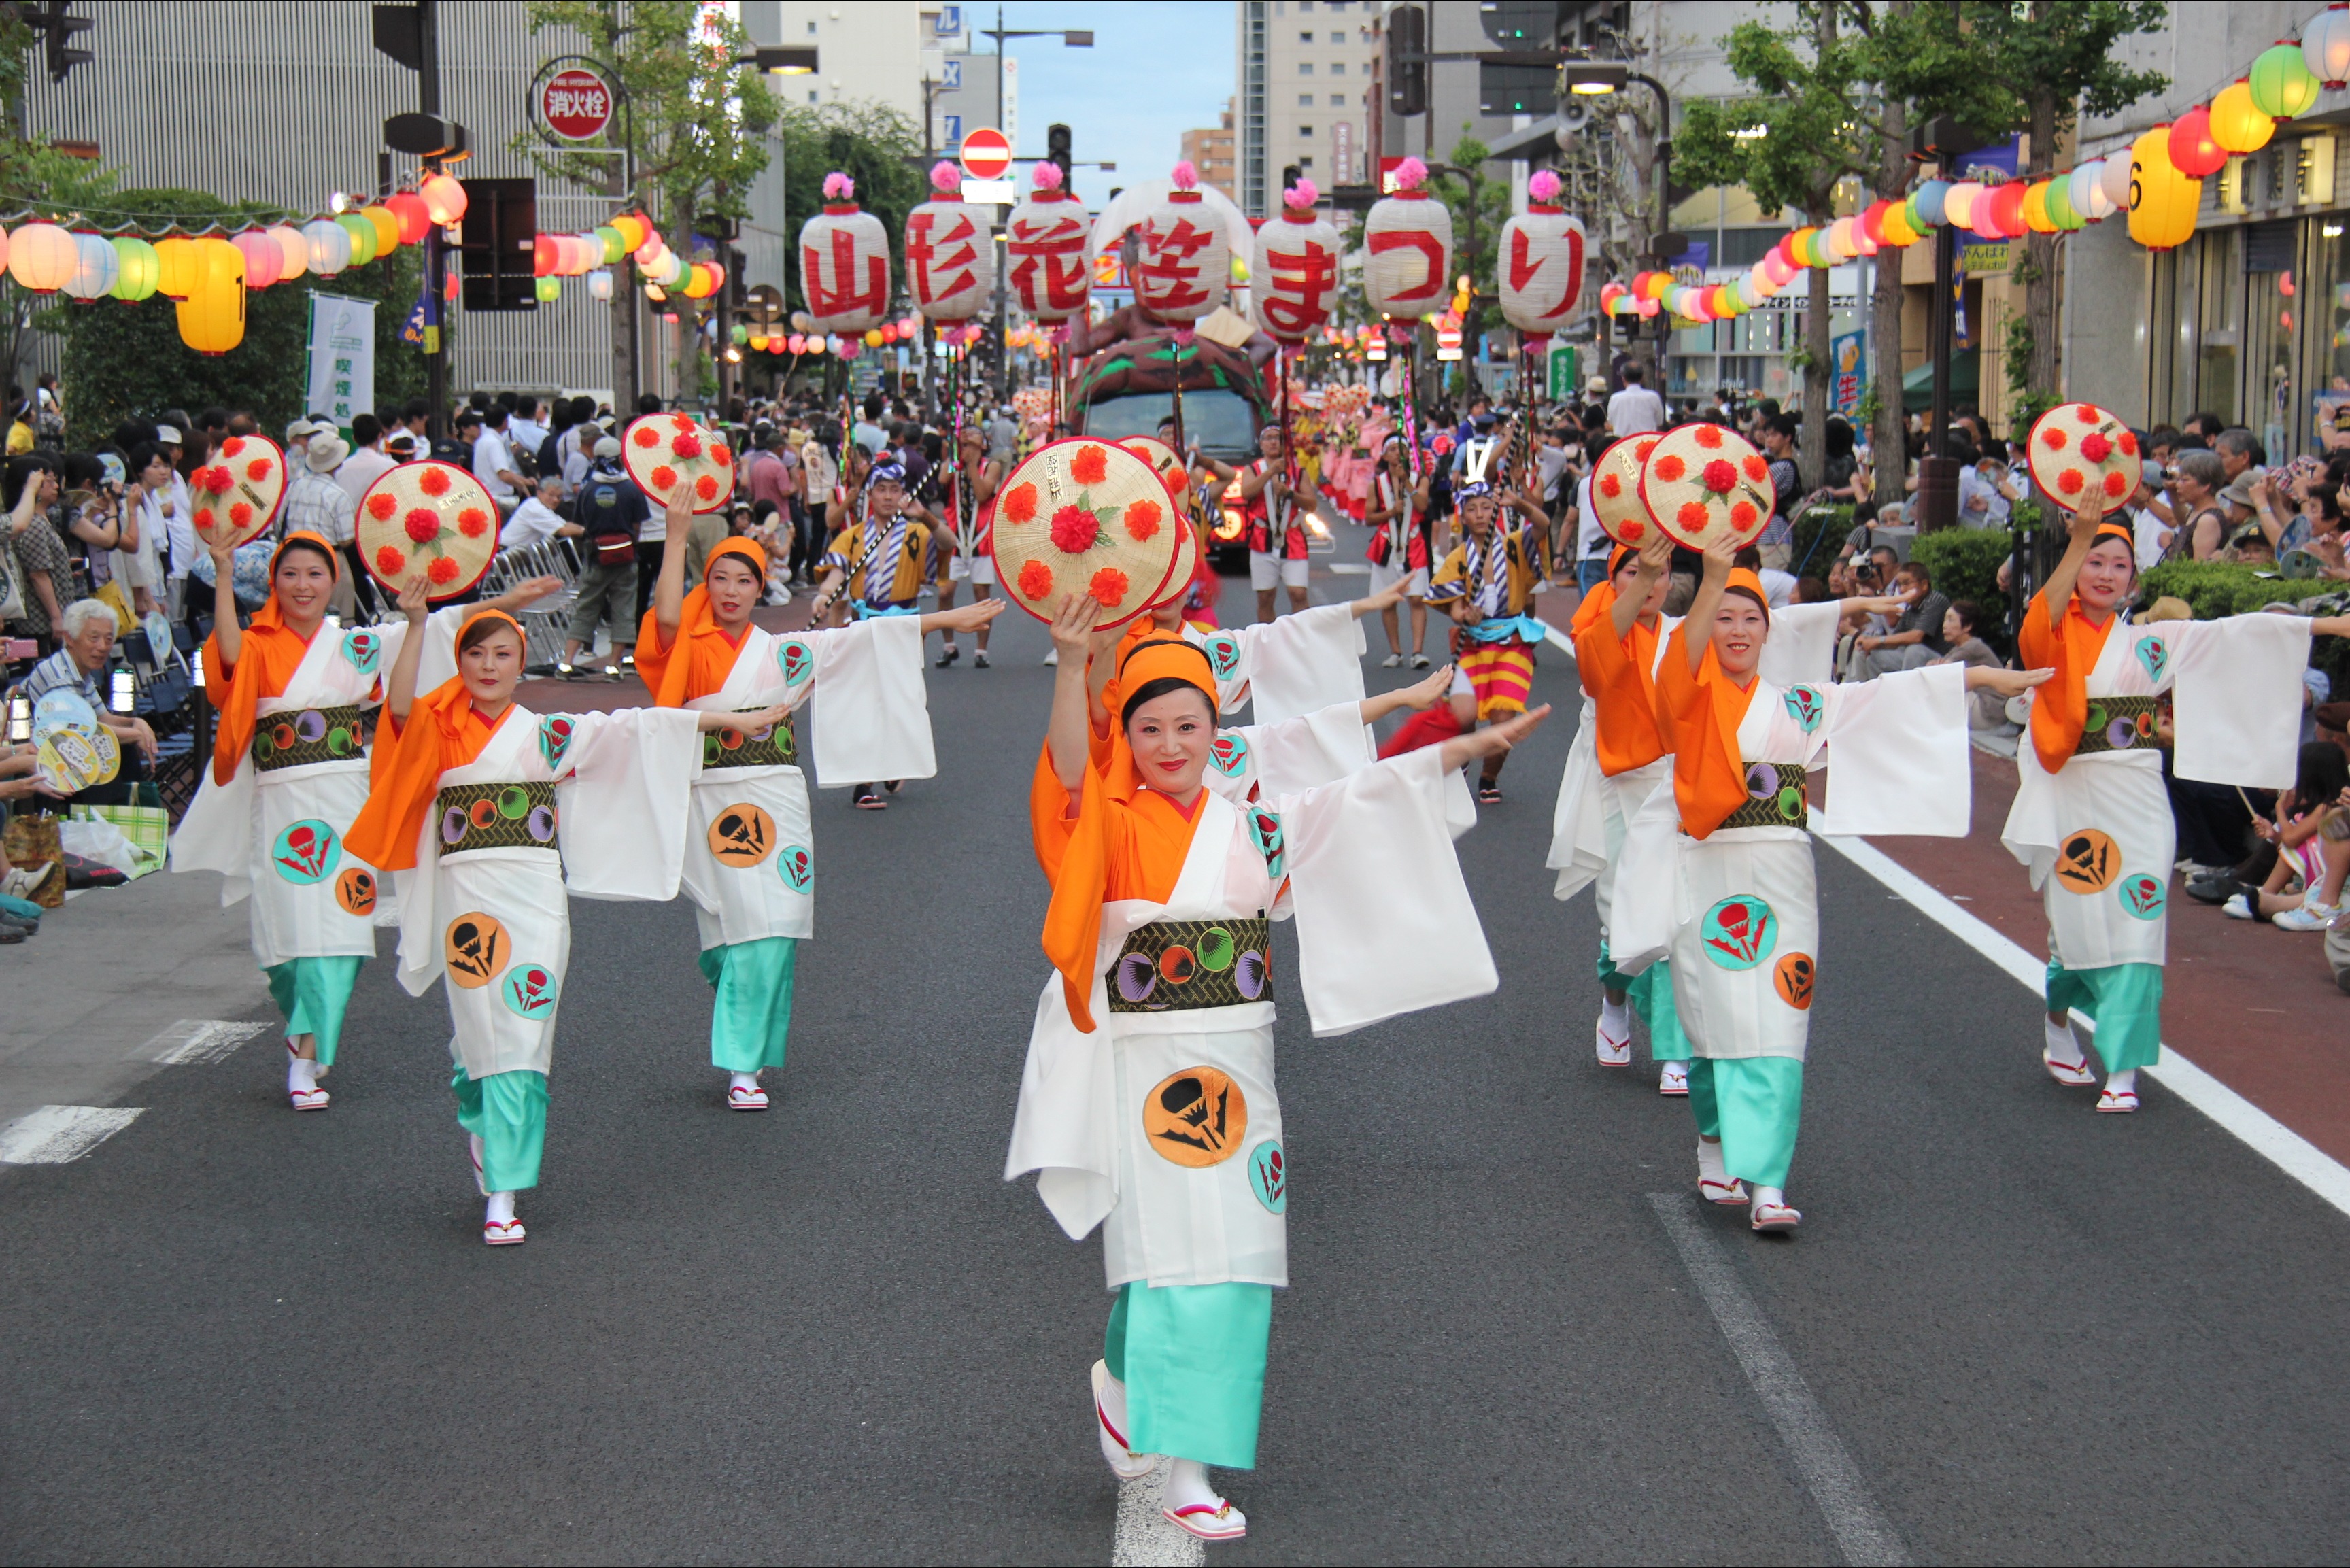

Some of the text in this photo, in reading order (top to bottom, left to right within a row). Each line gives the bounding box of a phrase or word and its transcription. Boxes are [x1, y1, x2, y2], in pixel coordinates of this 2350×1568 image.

[548, 90, 606, 118] 消火栓
[569, 79, 598, 87] HYDRANT
[2130, 162, 2142, 211] 6
[235, 275, 243, 322] 1
[805, 229, 885, 317] 山
[906, 214, 976, 305] 形
[1009, 218, 1087, 310] 花
[1140, 217, 1212, 310] 笠
[1264, 241, 1335, 332] ま
[1368, 231, 1444, 301] つ
[1510, 227, 1582, 318] り
[335, 358, 352, 418] 喫煙処
